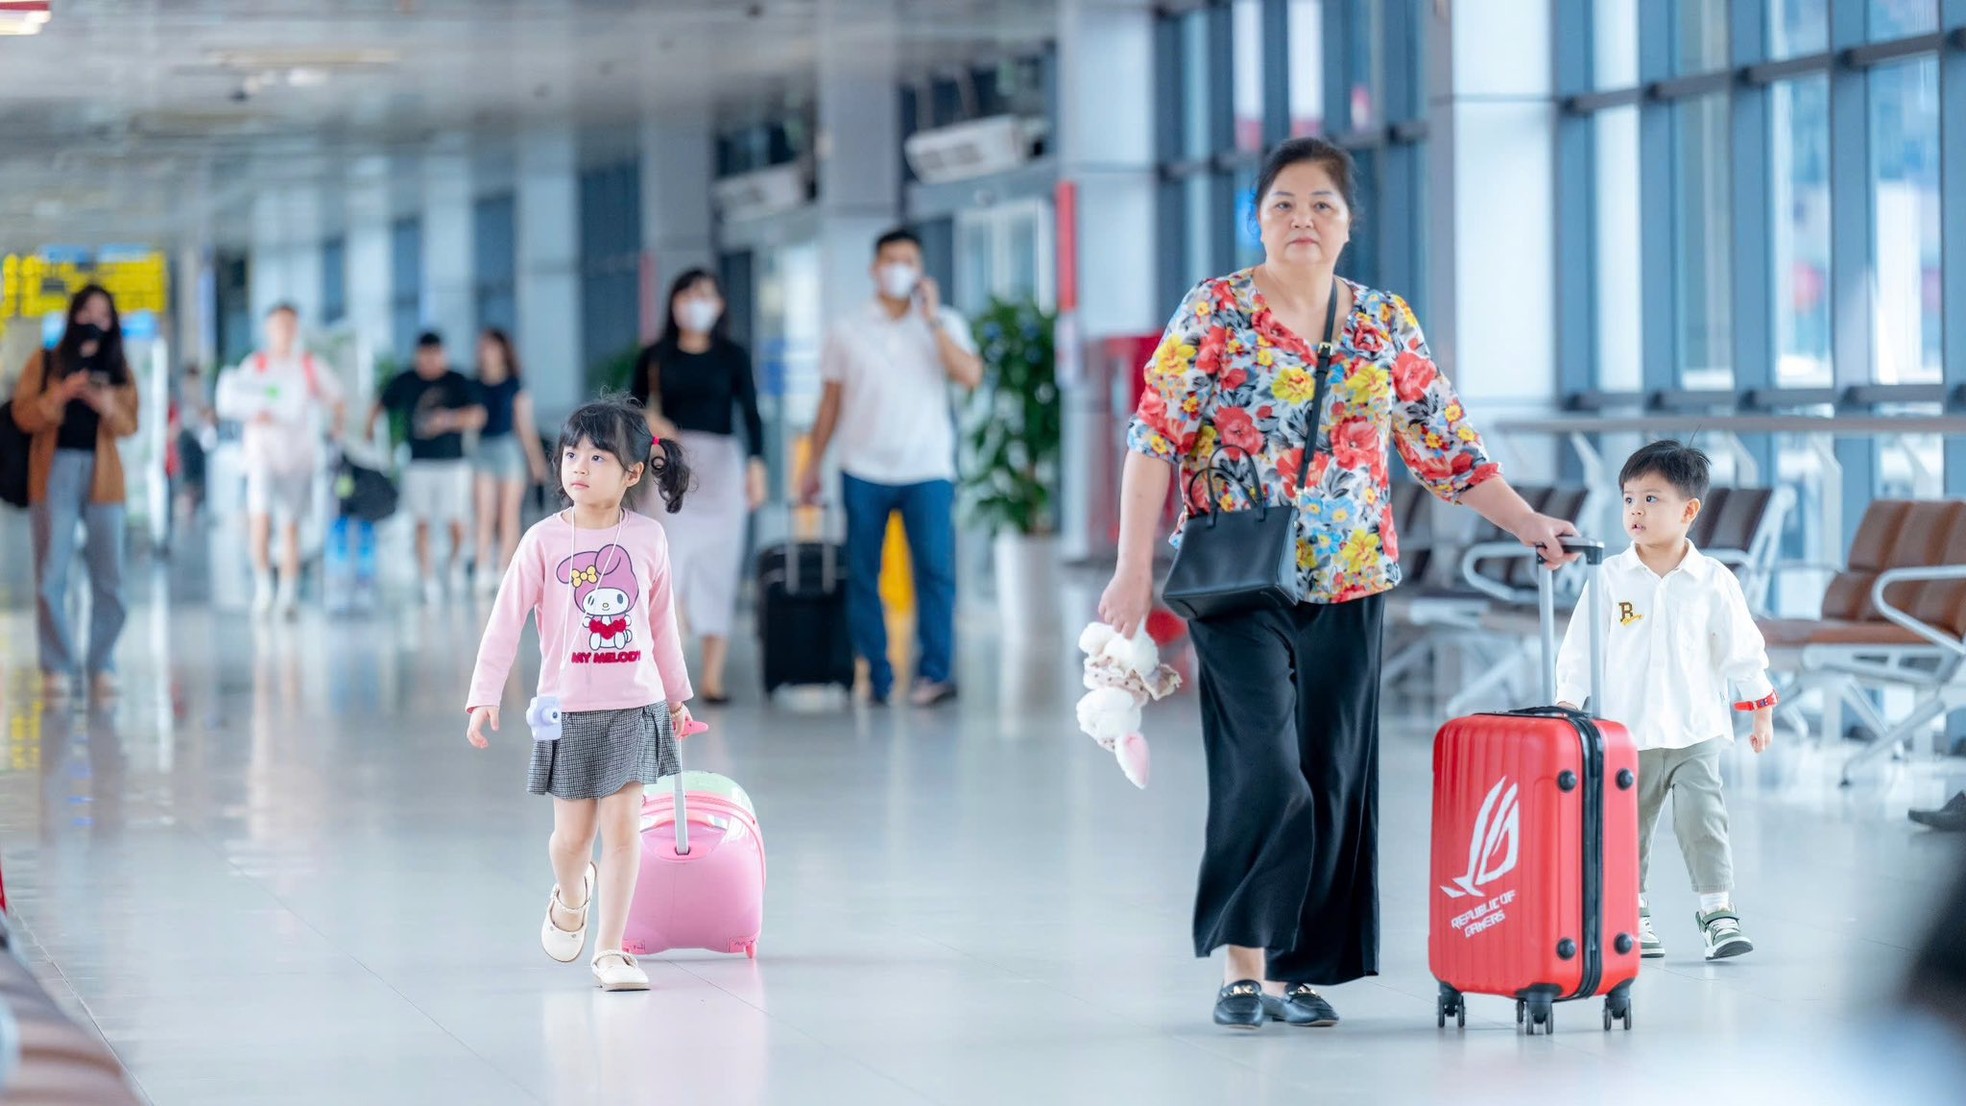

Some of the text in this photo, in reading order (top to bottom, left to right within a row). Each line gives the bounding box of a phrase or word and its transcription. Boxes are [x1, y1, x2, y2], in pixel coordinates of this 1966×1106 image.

[571, 651, 591, 663] MY
[1451, 889, 1516, 929] REPUBLIC OF
[1464, 909, 1506, 938] GAMERS
